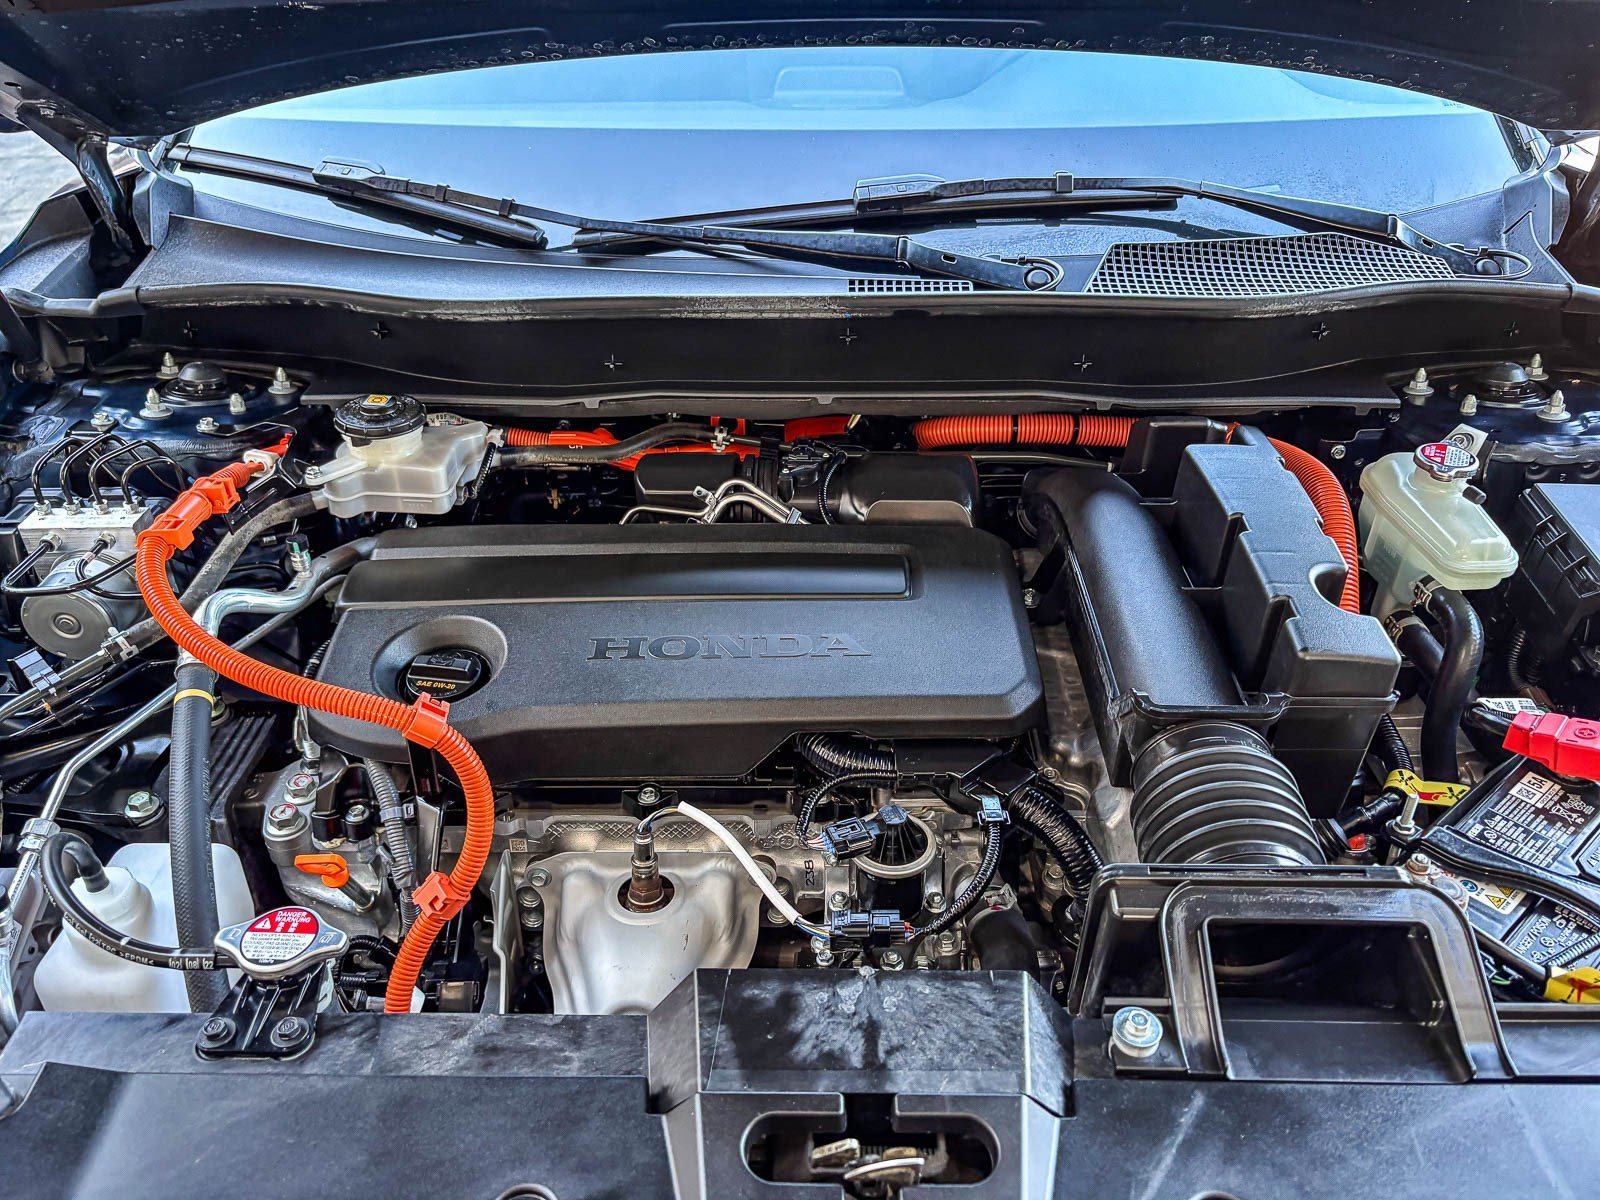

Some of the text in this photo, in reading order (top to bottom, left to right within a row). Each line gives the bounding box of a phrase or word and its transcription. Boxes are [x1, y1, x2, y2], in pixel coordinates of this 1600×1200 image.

[586, 633, 873, 661] HONDA
[433, 682, 456, 690] 0W-20
[1527, 776, 1548, 789] 5A
[804, 859, 815, 886] 238
